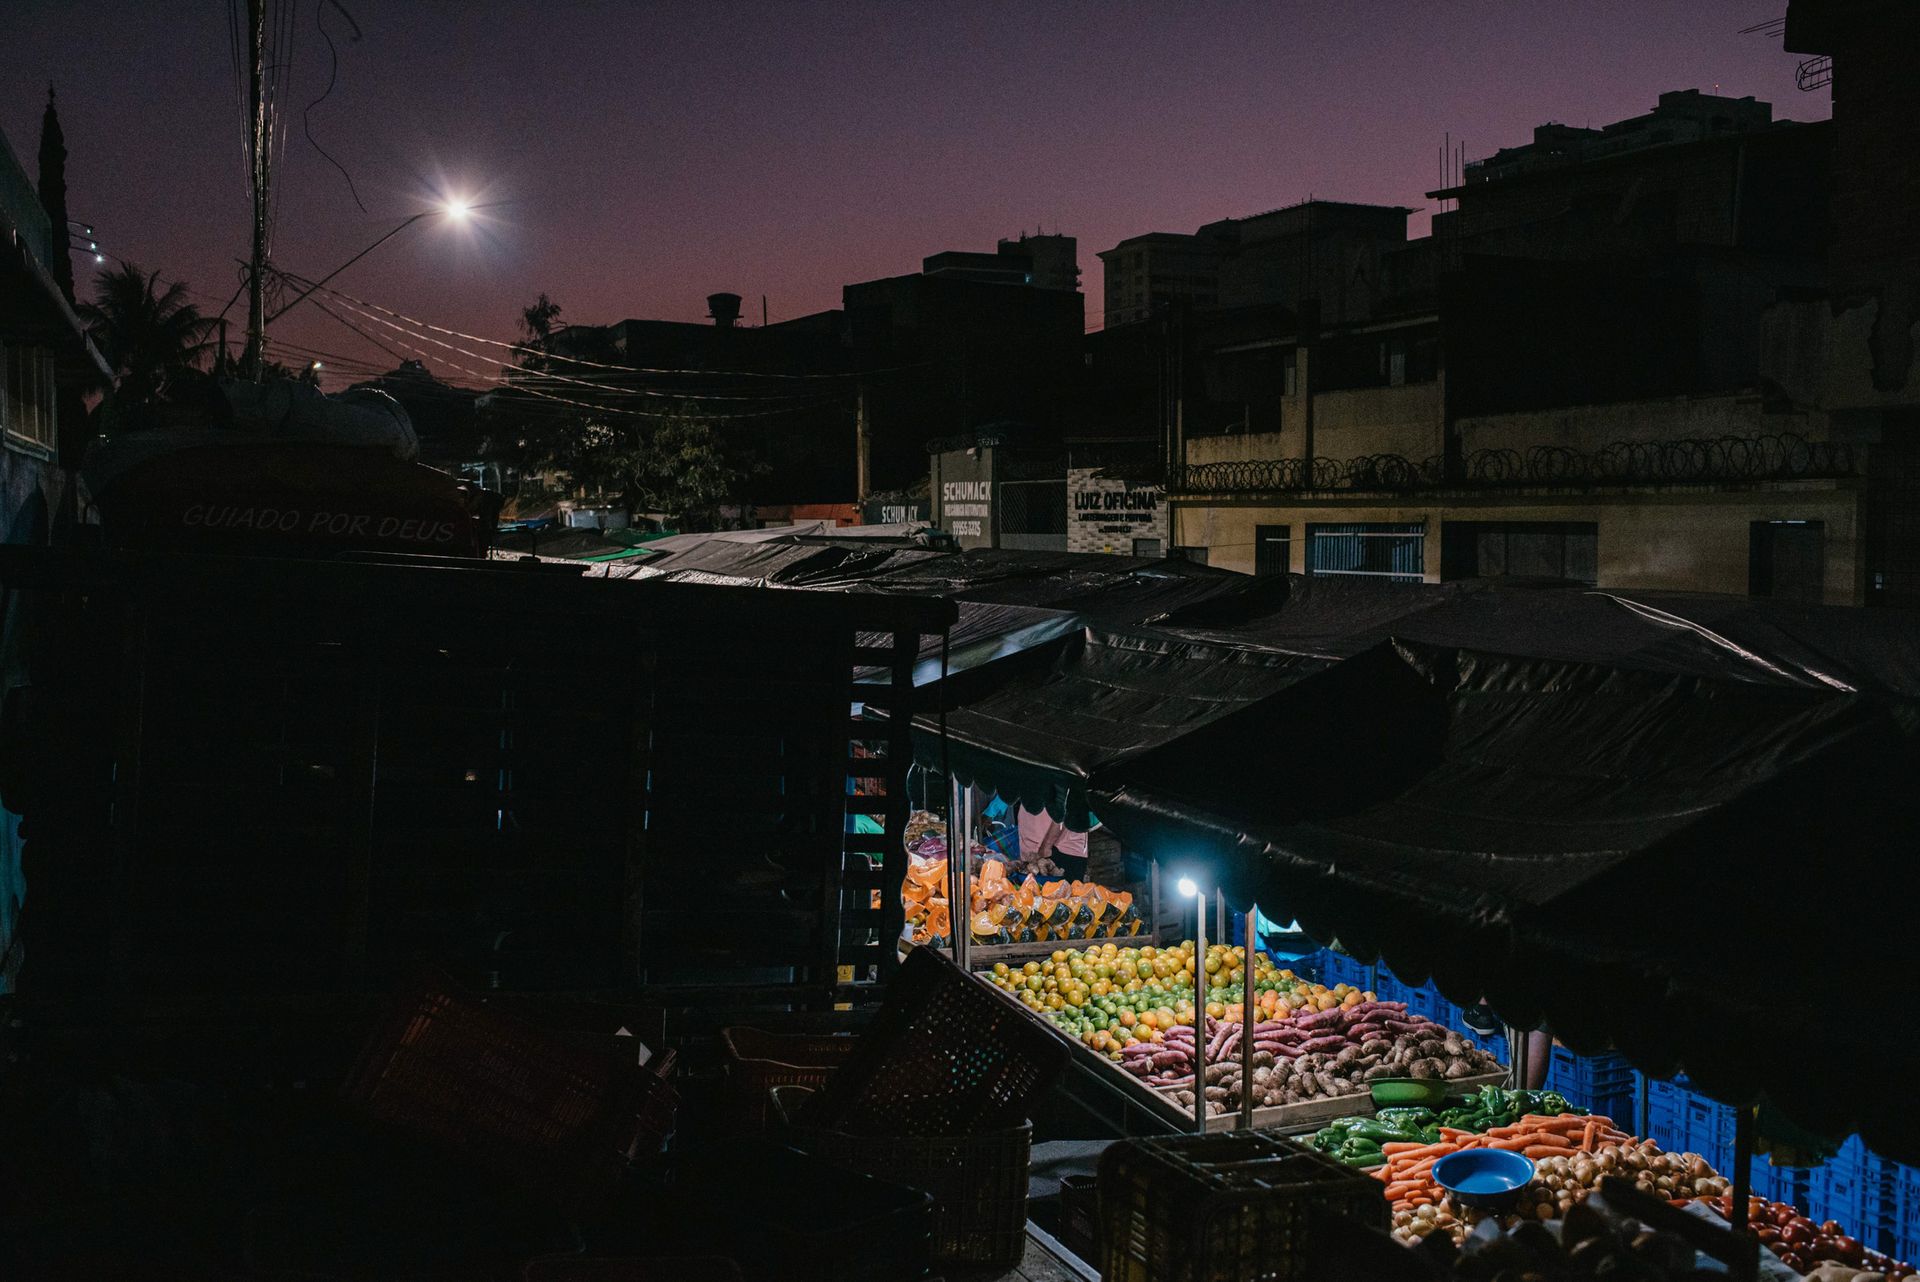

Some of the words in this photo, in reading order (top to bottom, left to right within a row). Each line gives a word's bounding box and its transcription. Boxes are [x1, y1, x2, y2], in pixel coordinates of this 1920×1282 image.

[943, 481, 992, 501] SCHUMACK
[1074, 492, 1101, 510] LUIZ
[1104, 492, 1157, 510] OFICINA
[182, 504, 300, 532] GUIADO
[307, 512, 371, 536] POR
[376, 517, 456, 542] DEUS
